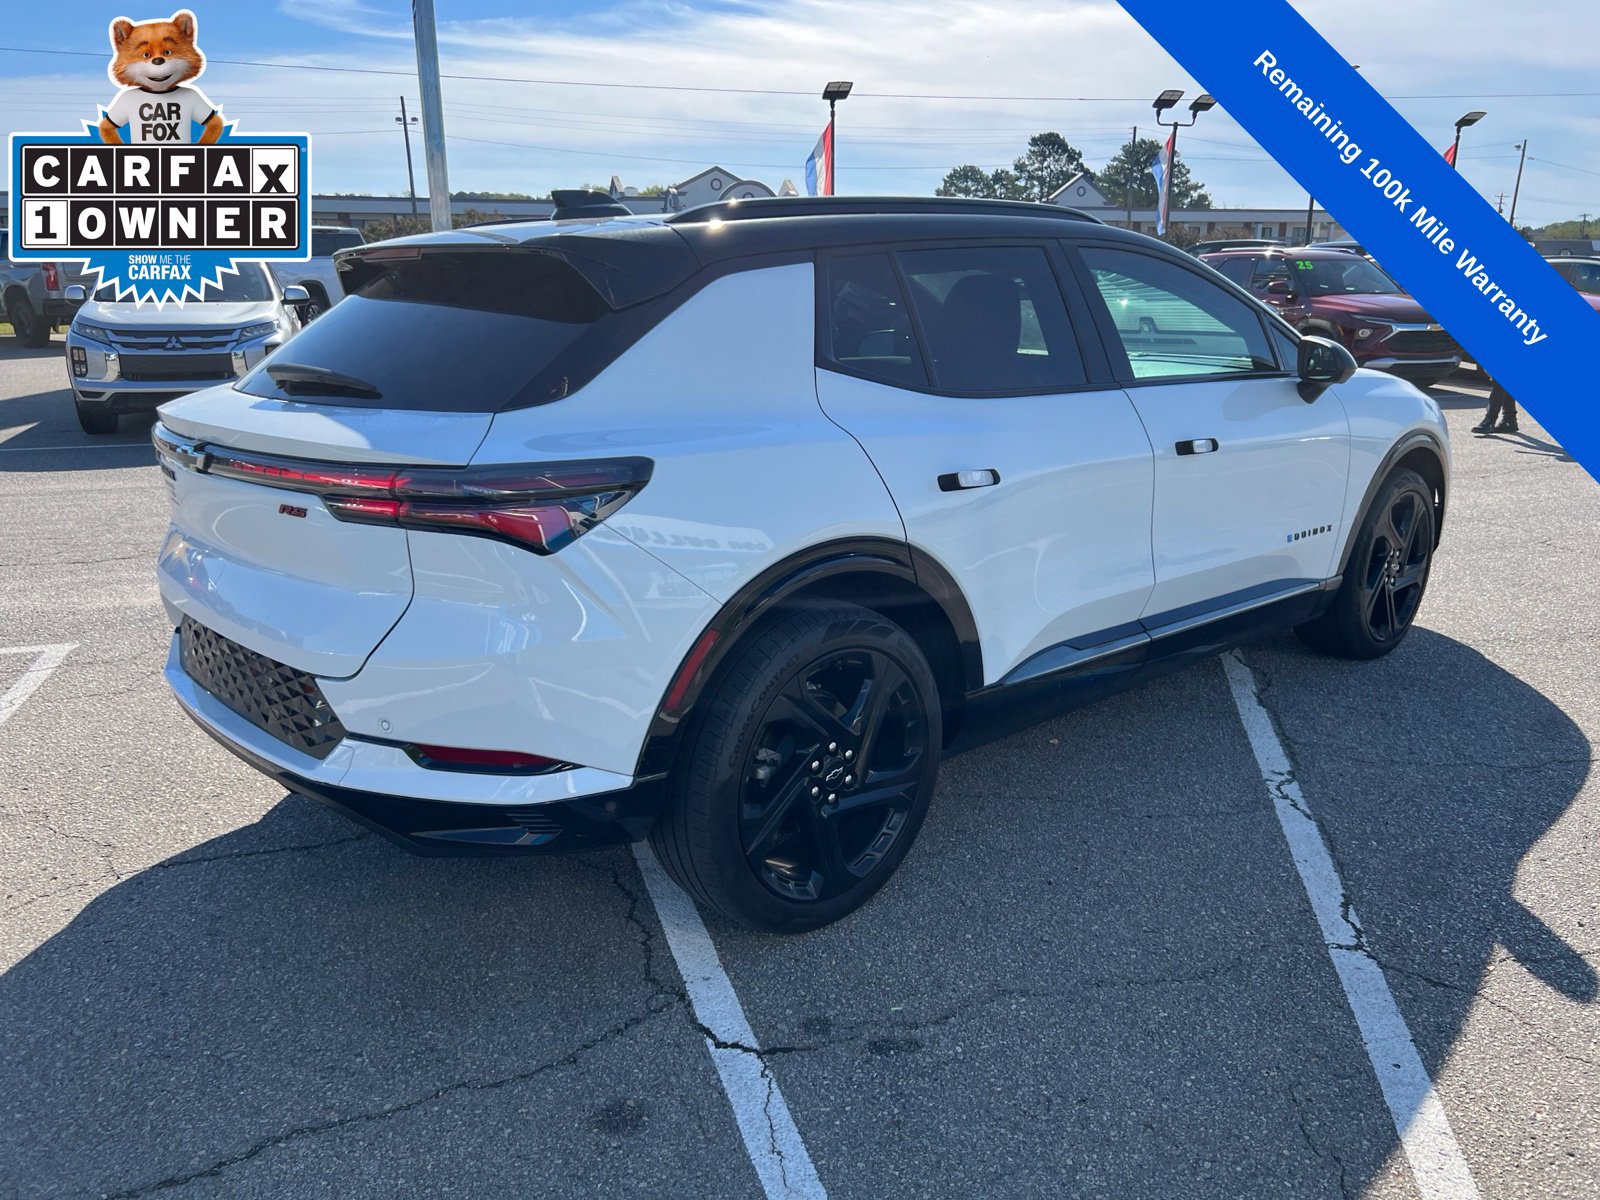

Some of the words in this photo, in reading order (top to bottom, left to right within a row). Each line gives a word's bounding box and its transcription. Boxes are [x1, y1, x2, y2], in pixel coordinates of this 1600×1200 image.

[1296, 260, 1313, 270] 25
[279, 503, 308, 519] RS
[1286, 523, 1333, 543] EQUINOX
